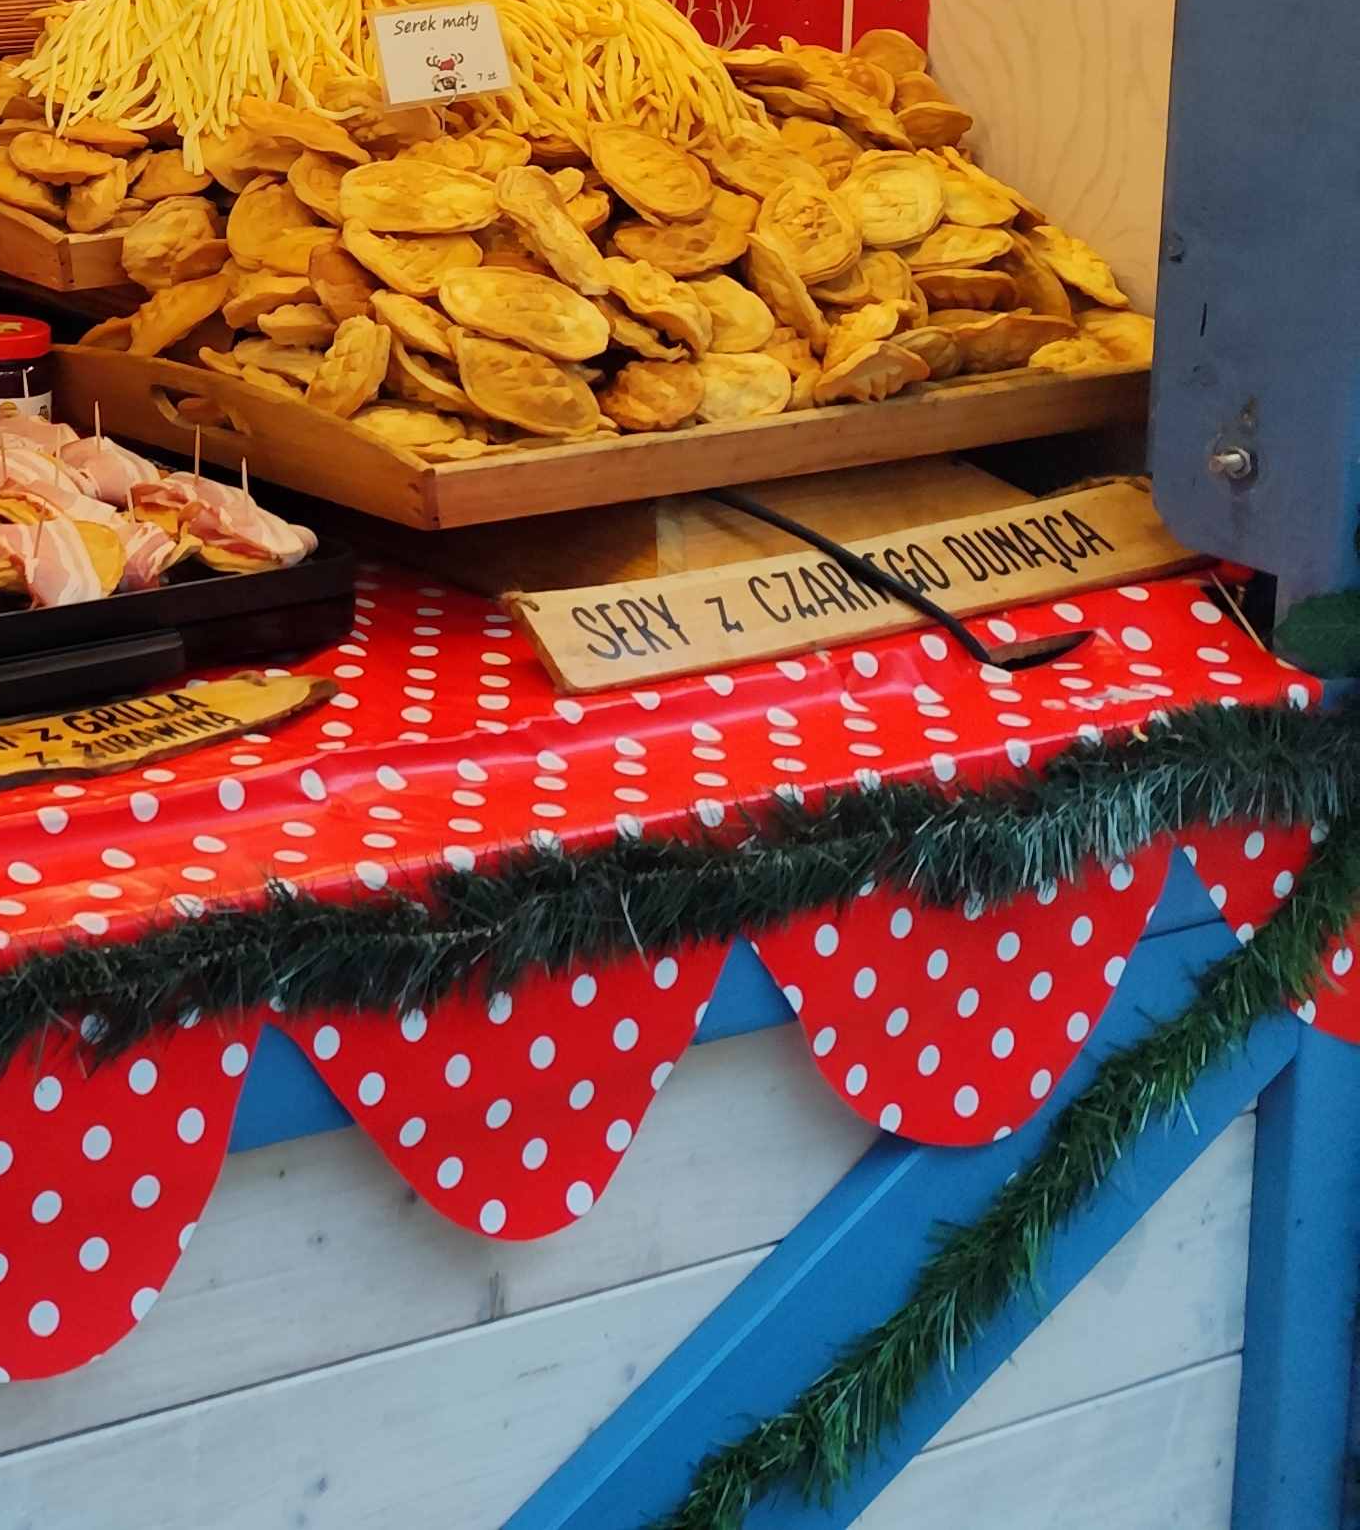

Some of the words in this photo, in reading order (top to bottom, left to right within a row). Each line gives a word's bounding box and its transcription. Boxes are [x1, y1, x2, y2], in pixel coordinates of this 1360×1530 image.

[393, 15, 437, 36] Serek
[571, 593, 691, 661] SERY
[747, 543, 951, 623] CZARGO
[941, 508, 1116, 583] DUNAJCA
[62, 693, 210, 735] GRILLA
